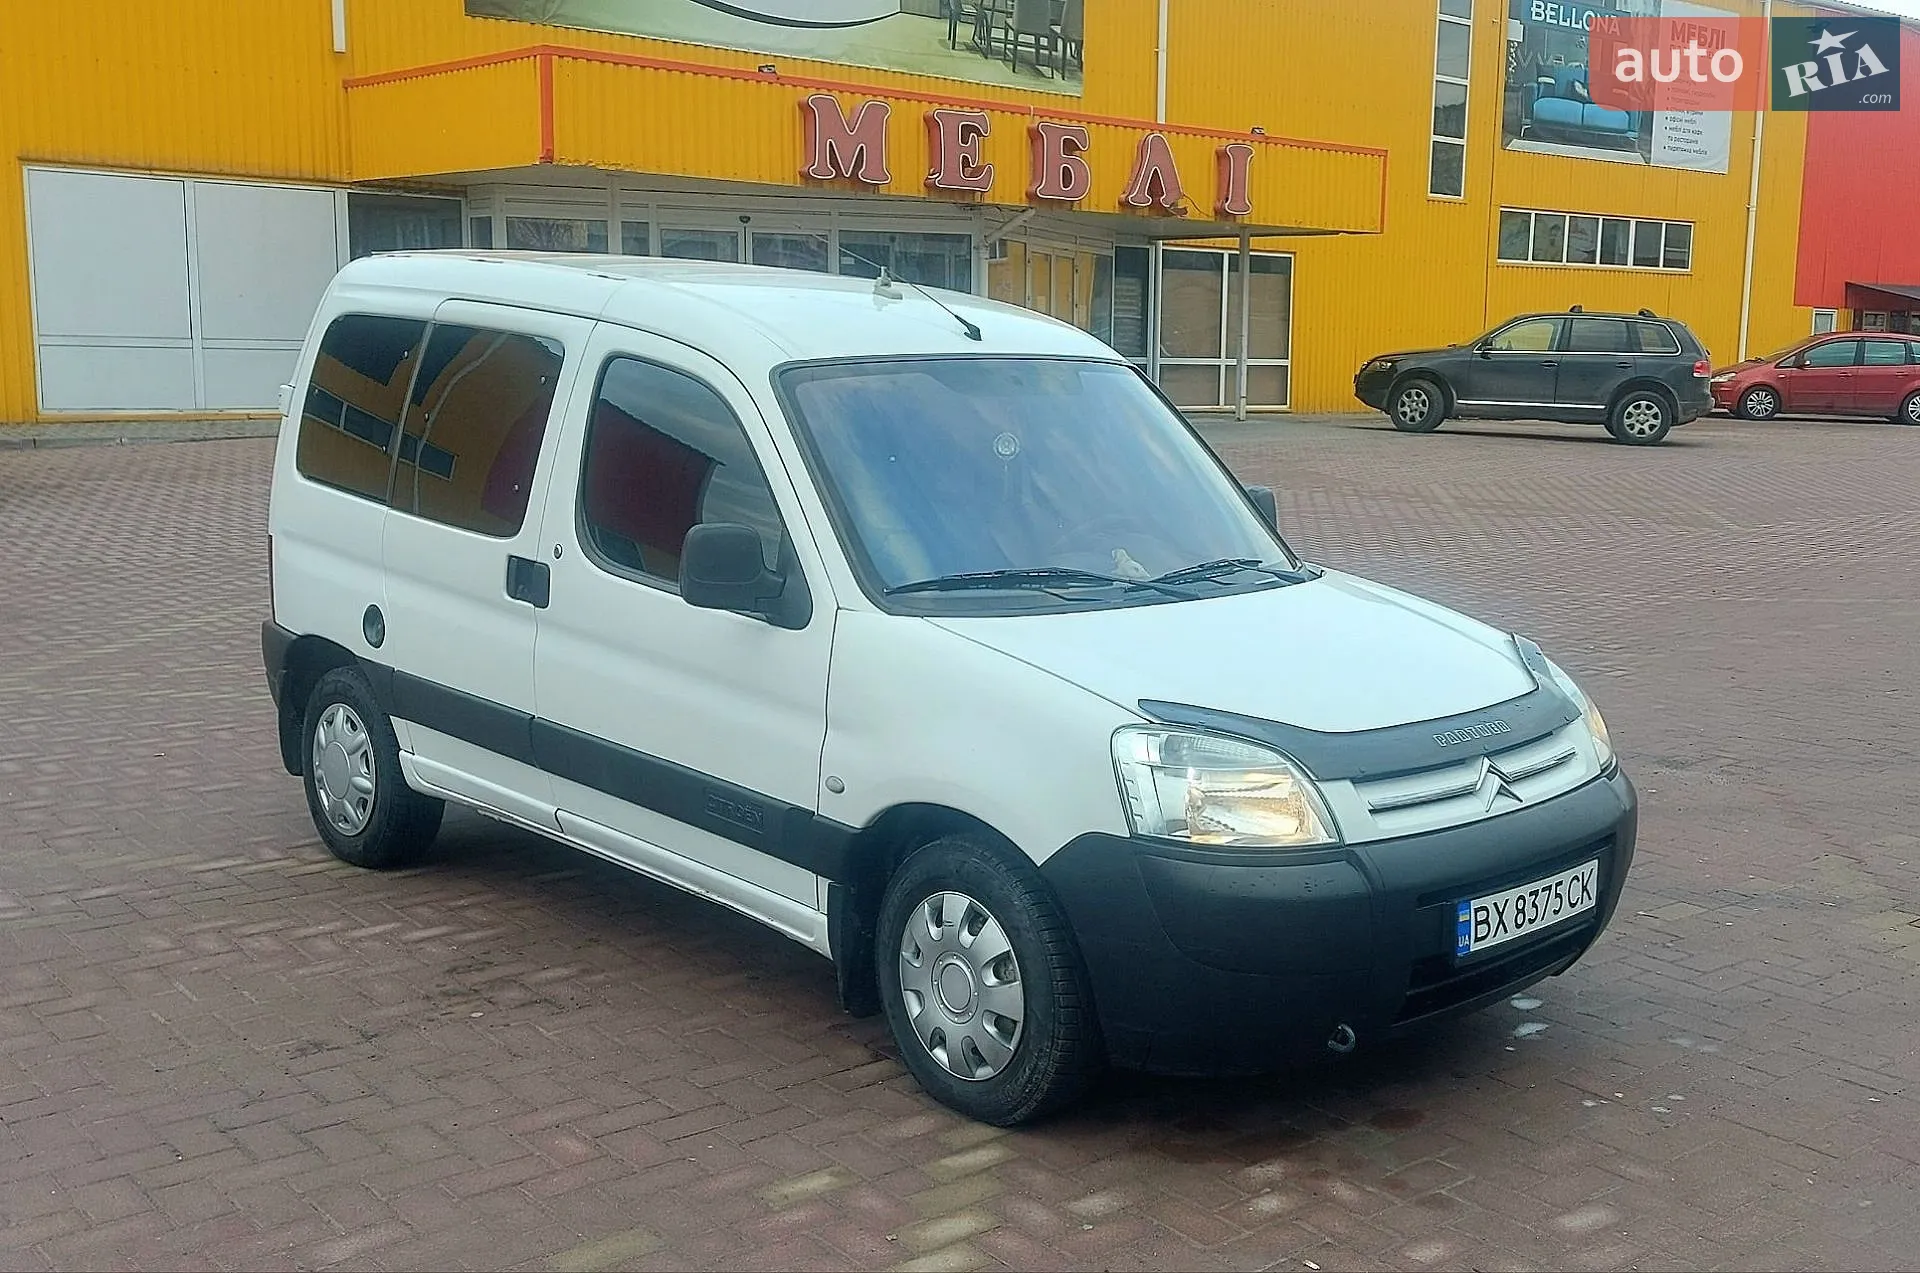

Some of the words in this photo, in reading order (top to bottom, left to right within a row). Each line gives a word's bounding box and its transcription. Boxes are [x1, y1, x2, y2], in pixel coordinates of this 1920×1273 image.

[1530, 0, 1621, 36] BELLONA
[1670, 20, 1727, 50] МЕБЛІ
[800, 94, 1255, 216] МЕБЛІ
[1432, 719, 1511, 748] PARTNER
[1473, 899, 1509, 943] BX
[1514, 880, 1563, 929] 8375
[1567, 867, 1595, 910] CK
[1458, 935, 1470, 948] UA
